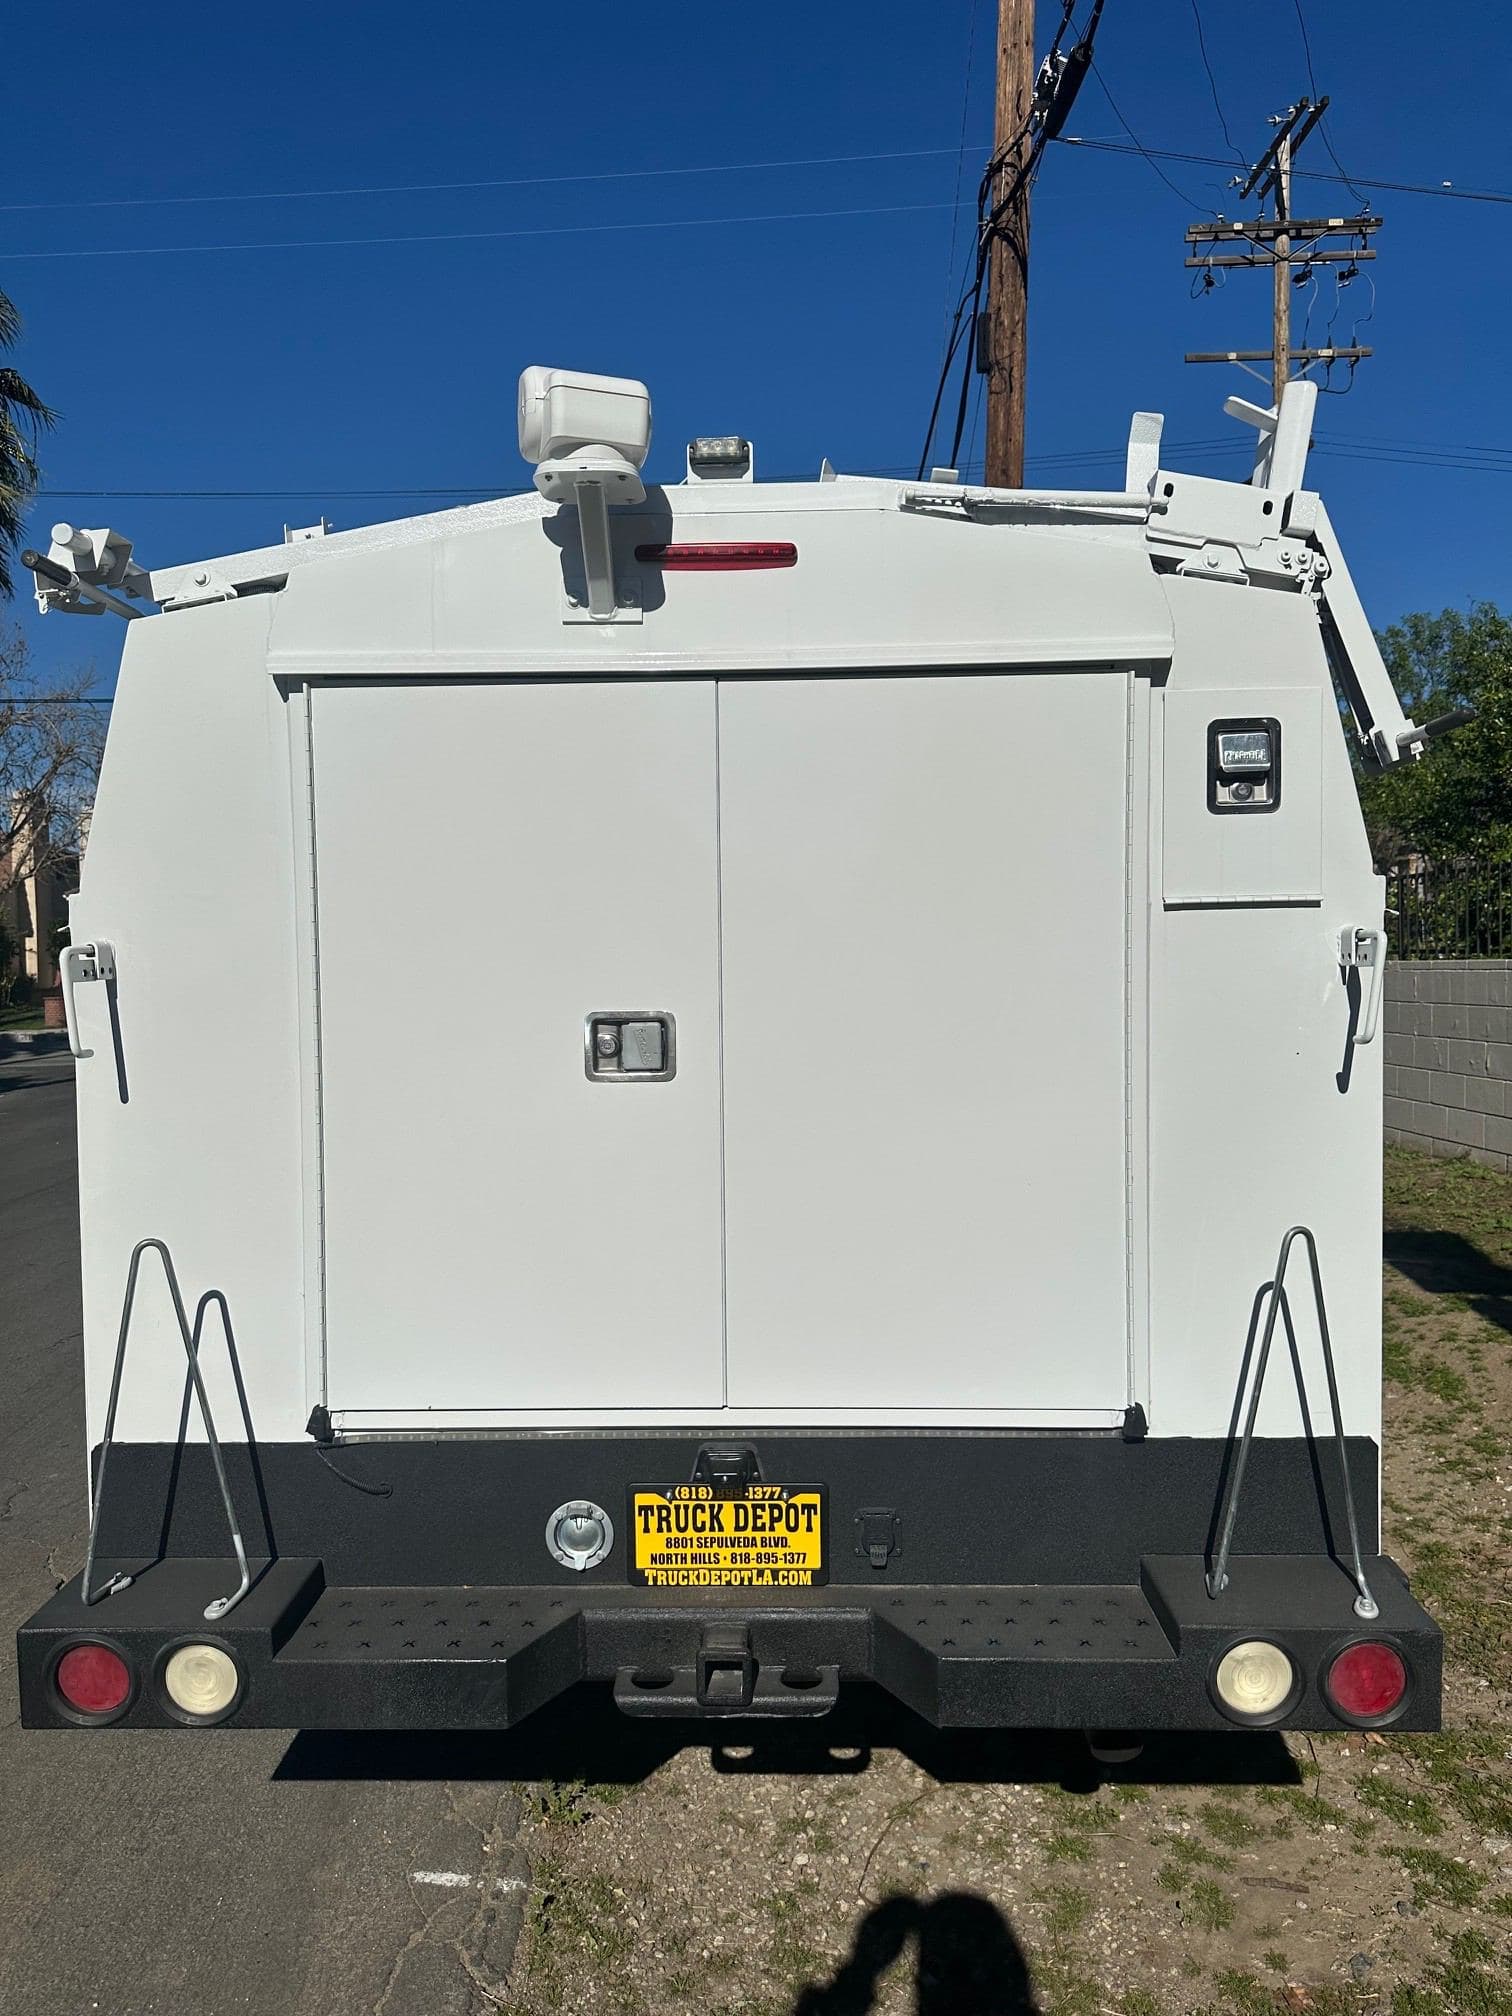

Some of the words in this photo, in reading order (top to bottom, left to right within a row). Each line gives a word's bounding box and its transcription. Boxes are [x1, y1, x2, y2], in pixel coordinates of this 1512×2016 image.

[674, 1486, 713, 1500] (818)
[638, 1503, 725, 1533] TRUCK
[733, 1502, 818, 1533] DEPOT
[665, 1536, 694, 1549] 8801
[696, 1536, 757, 1549] SEPULVEDA
[760, 1536, 791, 1549] BLVD.
[650, 1552, 687, 1565] NORTH
[690, 1552, 720, 1565] HILLS
[730, 1552, 807, 1565] 818-895-1377
